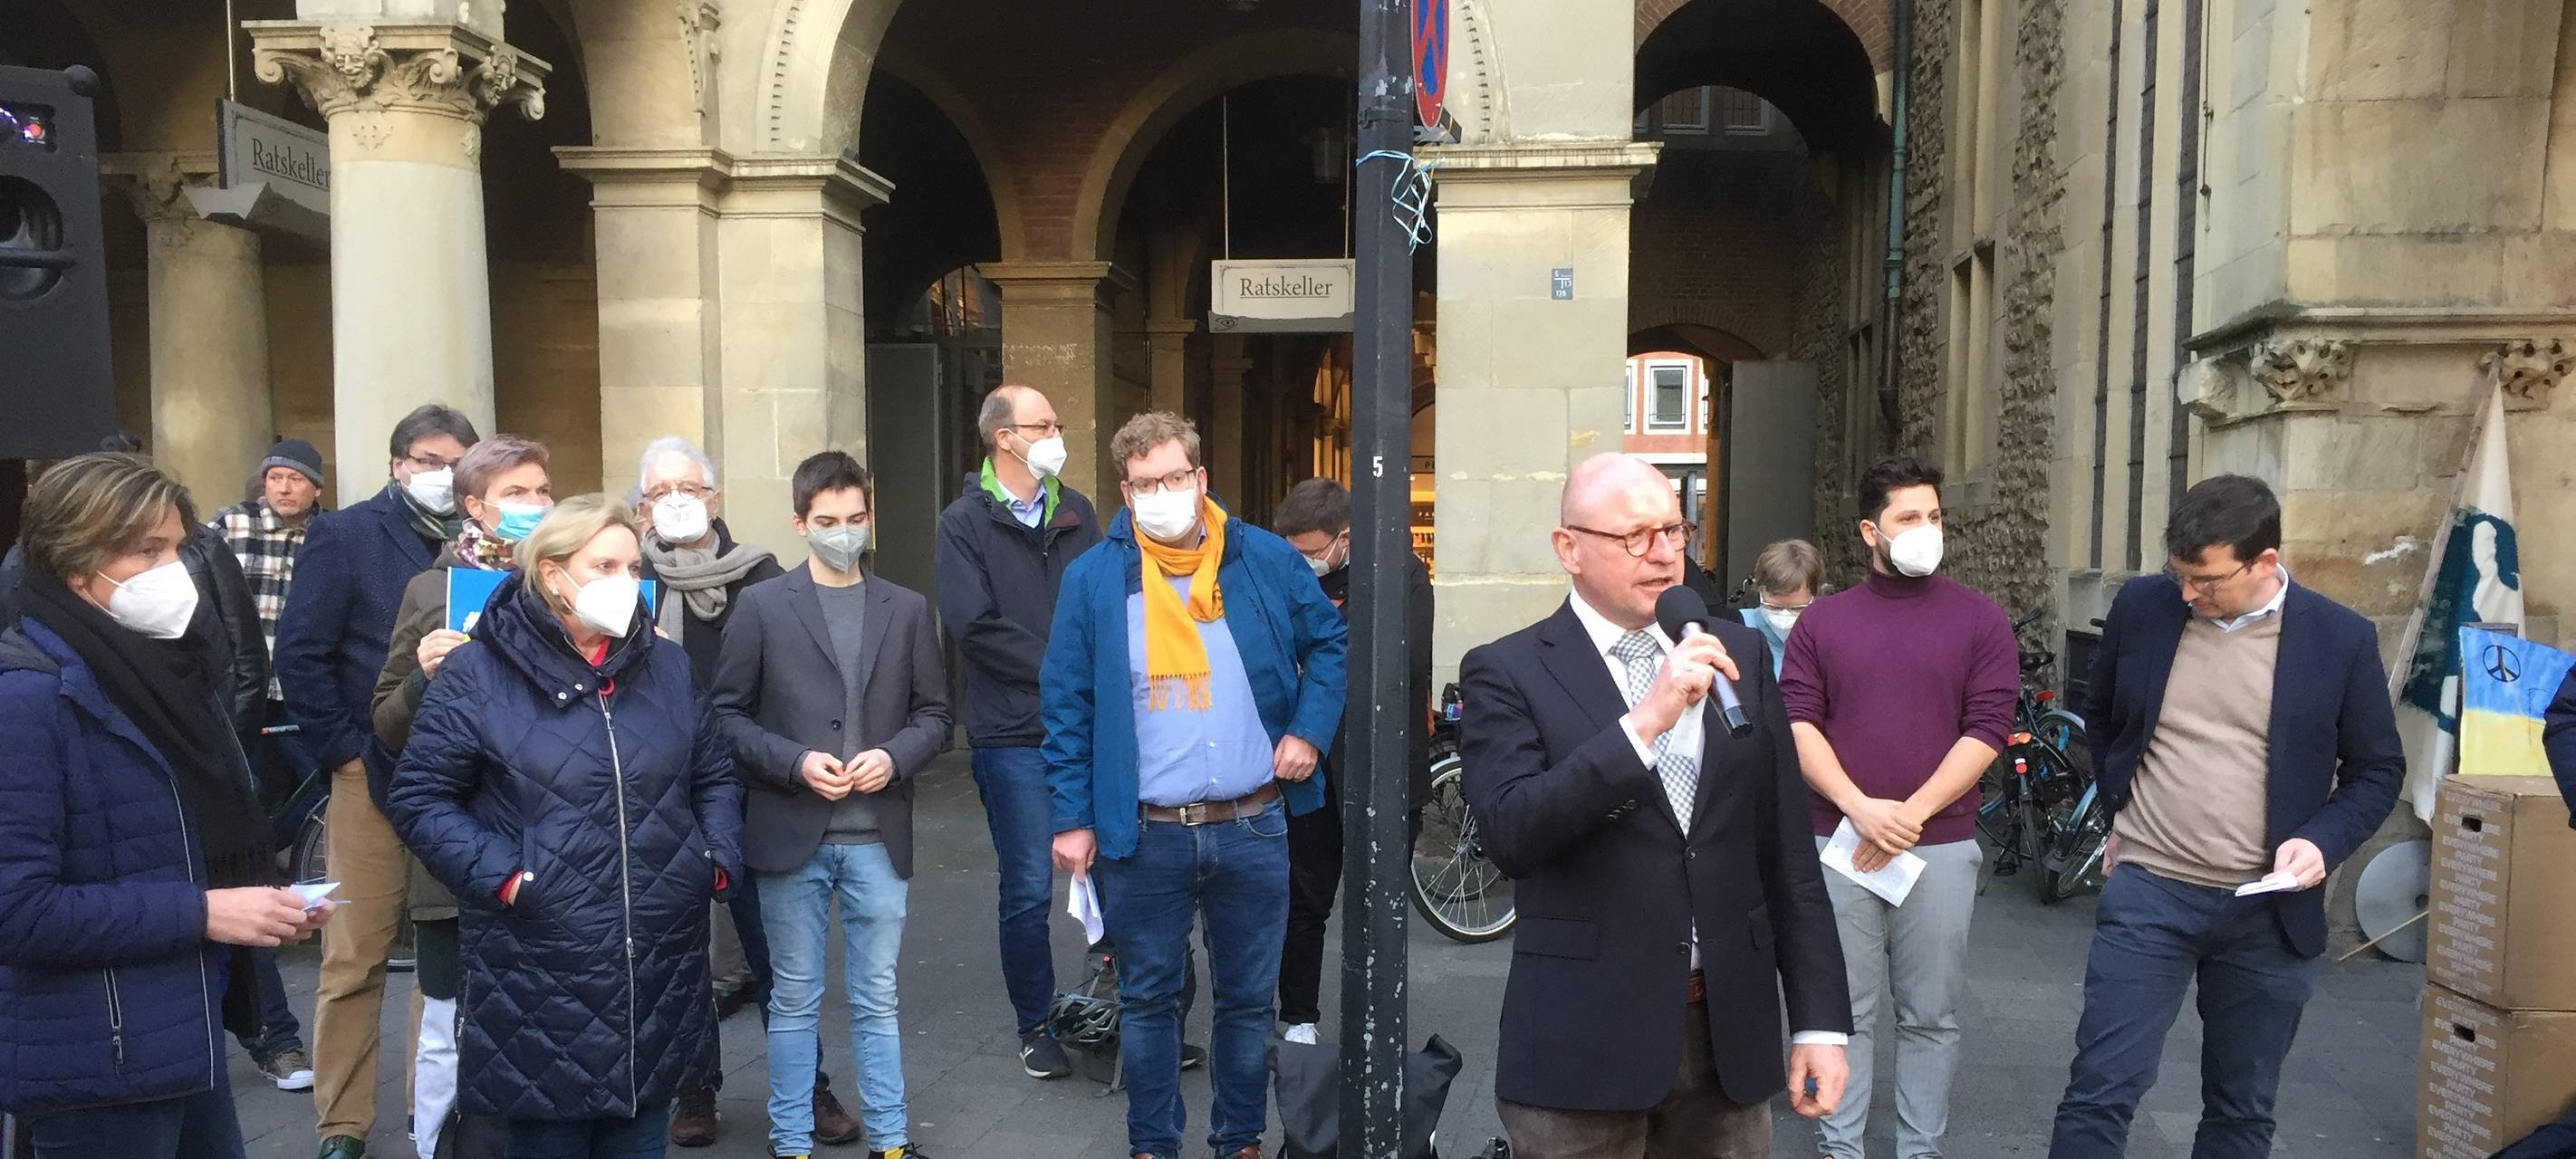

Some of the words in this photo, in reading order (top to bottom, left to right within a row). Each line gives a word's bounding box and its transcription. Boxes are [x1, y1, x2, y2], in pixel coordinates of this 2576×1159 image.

[252, 138, 330, 188] Ratskeller
[1239, 275, 1333, 297] Ratskeller
[1372, 455, 1383, 478] 5
[2442, 835, 2500, 859] EVERYWHERE
[2440, 857, 2498, 882] EVERYWHERE
[2439, 879, 2497, 905] EVERYWHERE
[2438, 901, 2495, 928] EVERYWHERE
[2437, 923, 2494, 951] EVERYWHERE
[2437, 944, 2494, 974] EVERYWHERE
[2432, 1039, 2496, 1072] EVERYWHERE
[2447, 1056, 2478, 1076] PARTY
[2430, 1060, 2494, 1095] EVERYWHERE
[2446, 1078, 2477, 1098] PARTY
[2429, 1082, 2494, 1117] EVERYWHERE
[2445, 1100, 2475, 1120] PARTY
[2427, 1104, 2492, 1140] EVERYWHERE
[2444, 1121, 2475, 1142] PARTY
